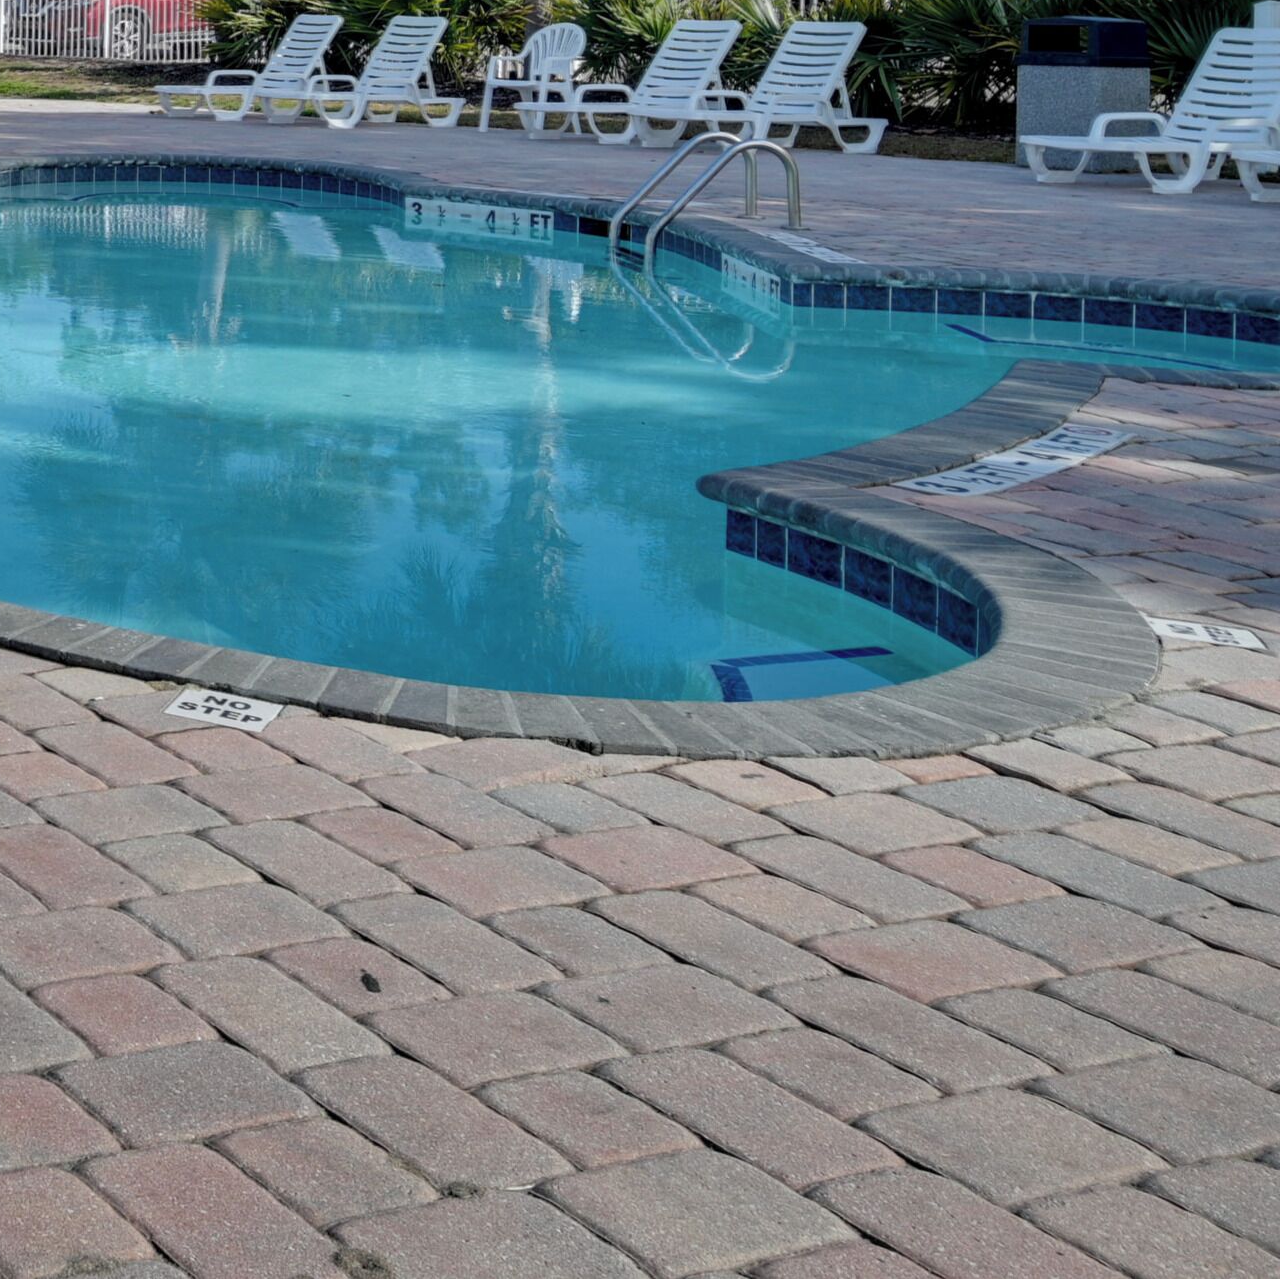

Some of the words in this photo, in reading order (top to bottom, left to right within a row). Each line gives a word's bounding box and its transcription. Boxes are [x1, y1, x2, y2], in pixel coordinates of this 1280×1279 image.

[530, 213, 551, 233] FT
[176, 701, 263, 724] STEP
[203, 695, 252, 711] NO
